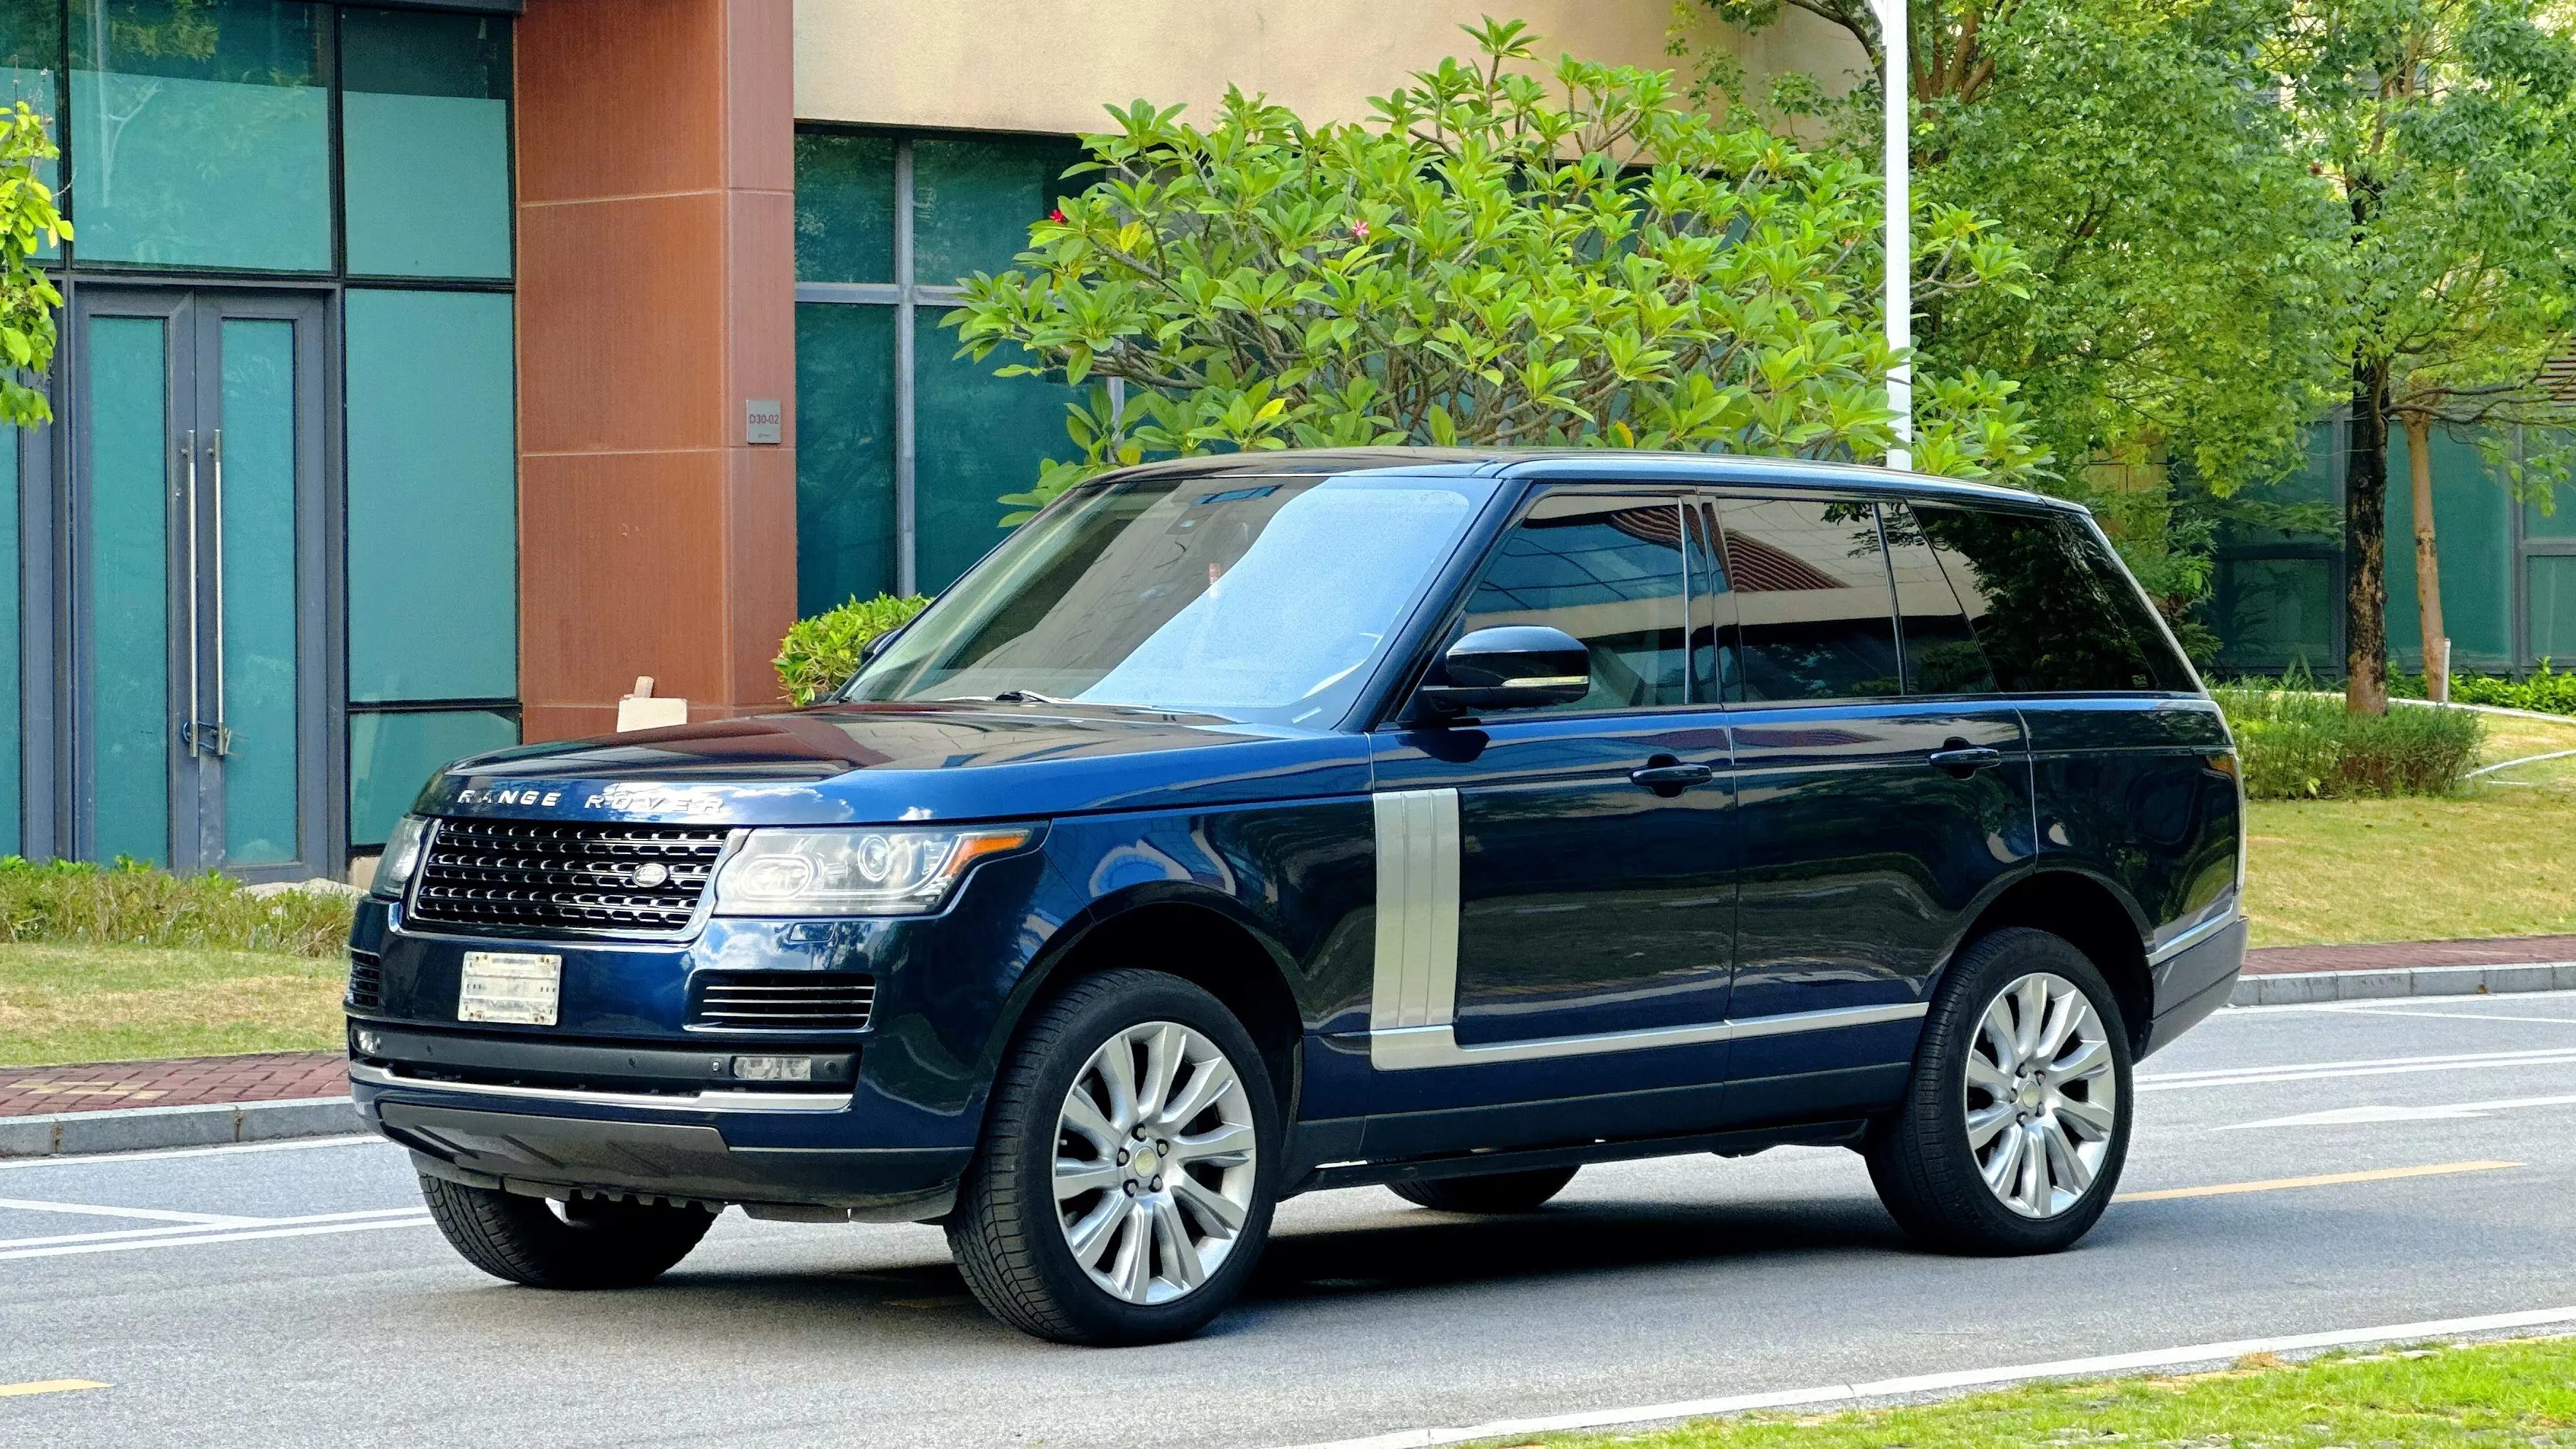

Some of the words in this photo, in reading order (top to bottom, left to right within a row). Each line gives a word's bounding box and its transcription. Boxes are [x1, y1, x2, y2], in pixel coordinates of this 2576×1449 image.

[749, 413, 780, 424] D30-02
[458, 789, 561, 807] RANGE
[585, 793, 724, 813] ROVER
